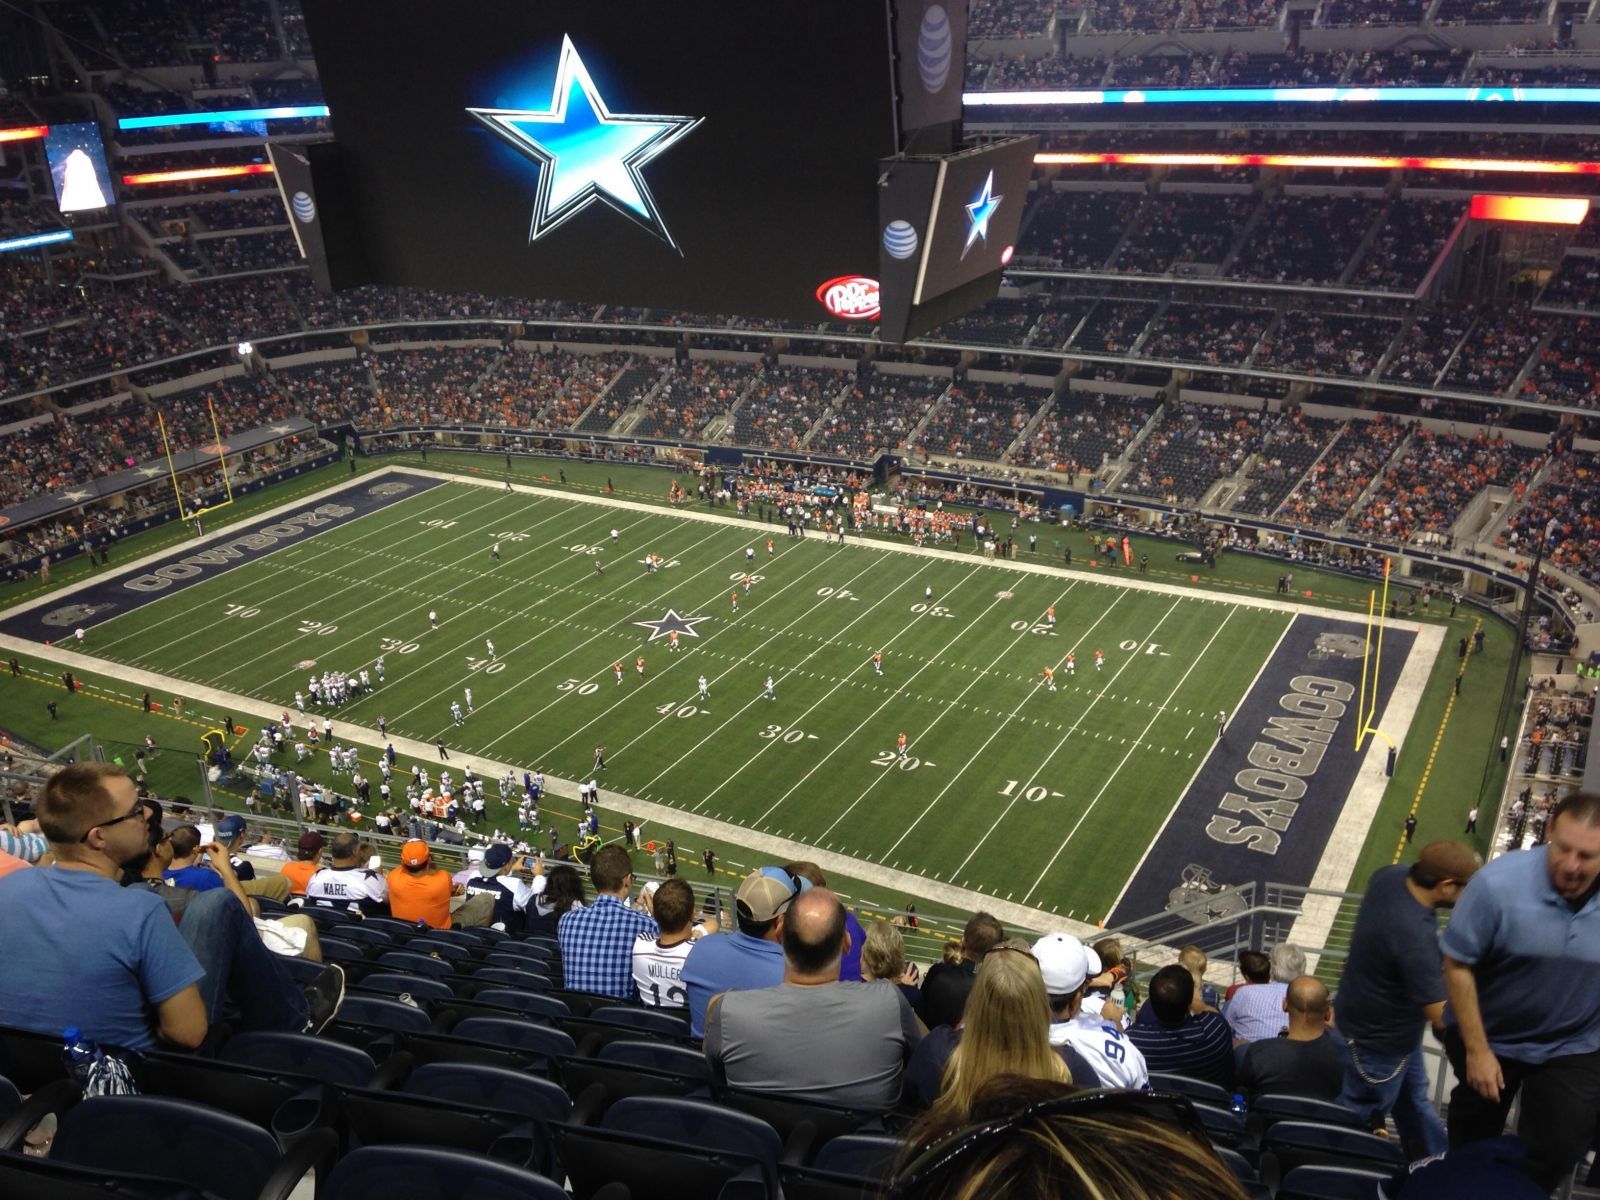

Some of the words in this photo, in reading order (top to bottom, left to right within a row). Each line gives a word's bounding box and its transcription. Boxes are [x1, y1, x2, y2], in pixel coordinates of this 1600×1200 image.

[123, 503, 355, 592] COWBOYS
[224, 604, 261, 619] 10
[298, 622, 338, 636] 20
[380, 639, 420, 654] 30
[556, 678, 599, 695] 50
[655, 702, 698, 719] 40
[758, 724, 805, 744] 30
[870, 751, 921, 771] 20
[1205, 675, 1355, 856] COWBOYS
[997, 779, 1048, 802] 10
[323, 882, 347, 896] WARE
